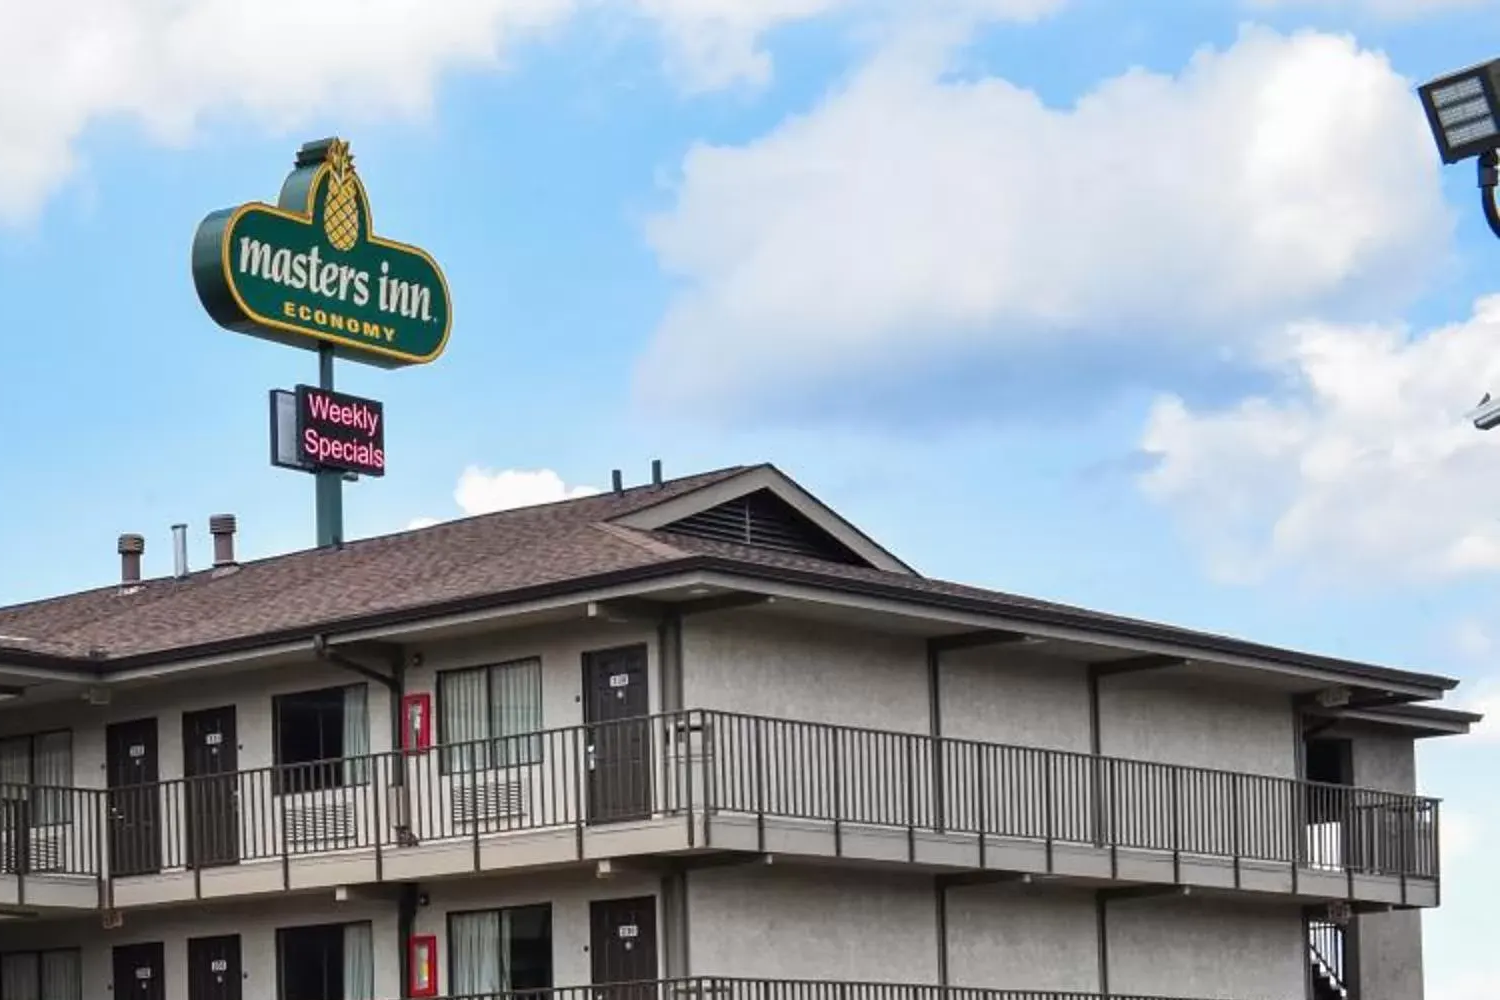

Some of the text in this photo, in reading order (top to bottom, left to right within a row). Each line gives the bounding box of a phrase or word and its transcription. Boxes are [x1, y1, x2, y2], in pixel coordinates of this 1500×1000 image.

[239, 236, 432, 321] masters inn
[283, 301, 395, 341] ECONOMY
[308, 393, 379, 437] Weekly
[304, 429, 384, 467] Specials
